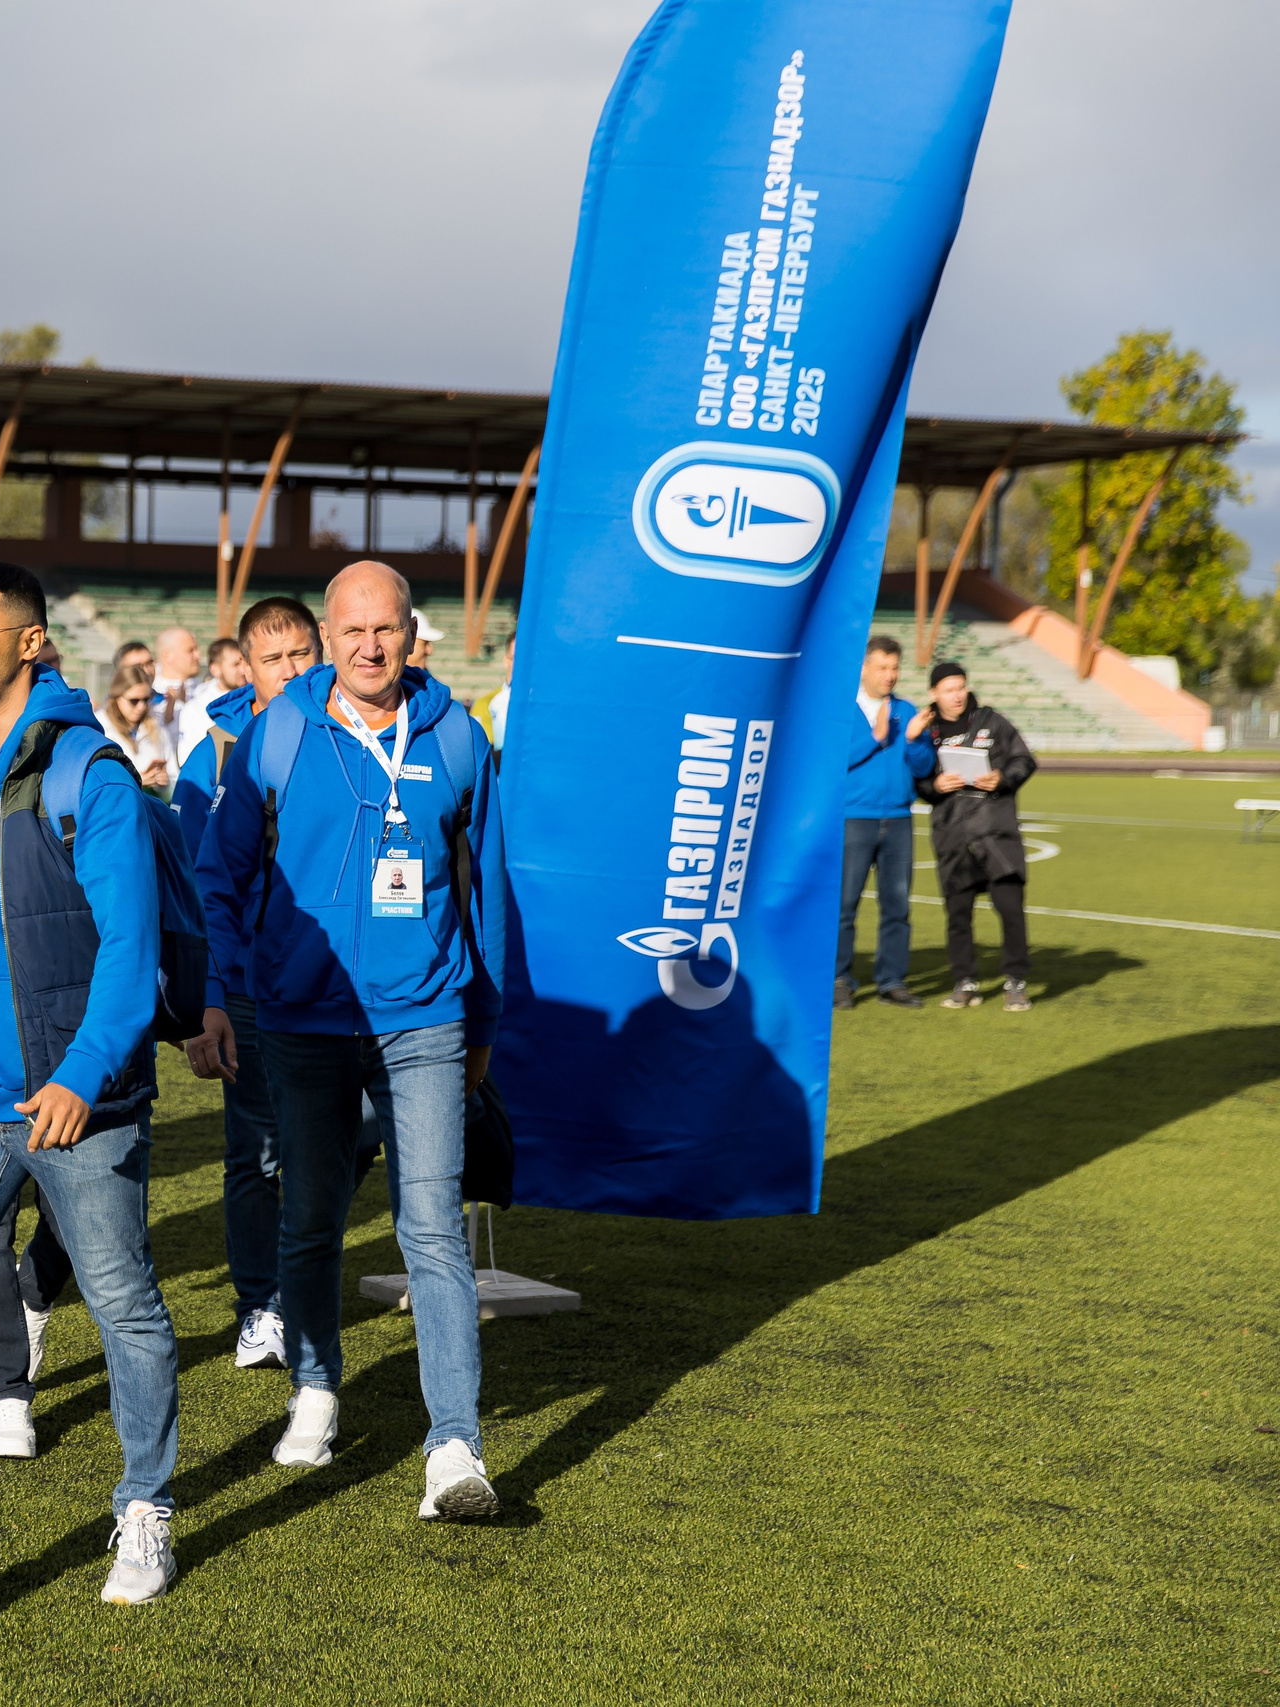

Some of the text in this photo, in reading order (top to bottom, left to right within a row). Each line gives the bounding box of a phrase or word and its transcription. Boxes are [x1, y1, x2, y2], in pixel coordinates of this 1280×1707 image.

[694, 230, 752, 427] СПАРТАКИАДА
[727, 49, 806, 429] ООО «ГАЗПРОМ ГАЗНАДЗОР»
[757, 182, 819, 433] САНКТ-ПЕТЕРБУРГ
[791, 367, 826, 437] 2025
[381, 906, 413, 914] УЧАСТНИК
[662, 712, 738, 919] ГАЗПРОМ
[719, 727, 768, 913] ГАЗНАДЗОР
